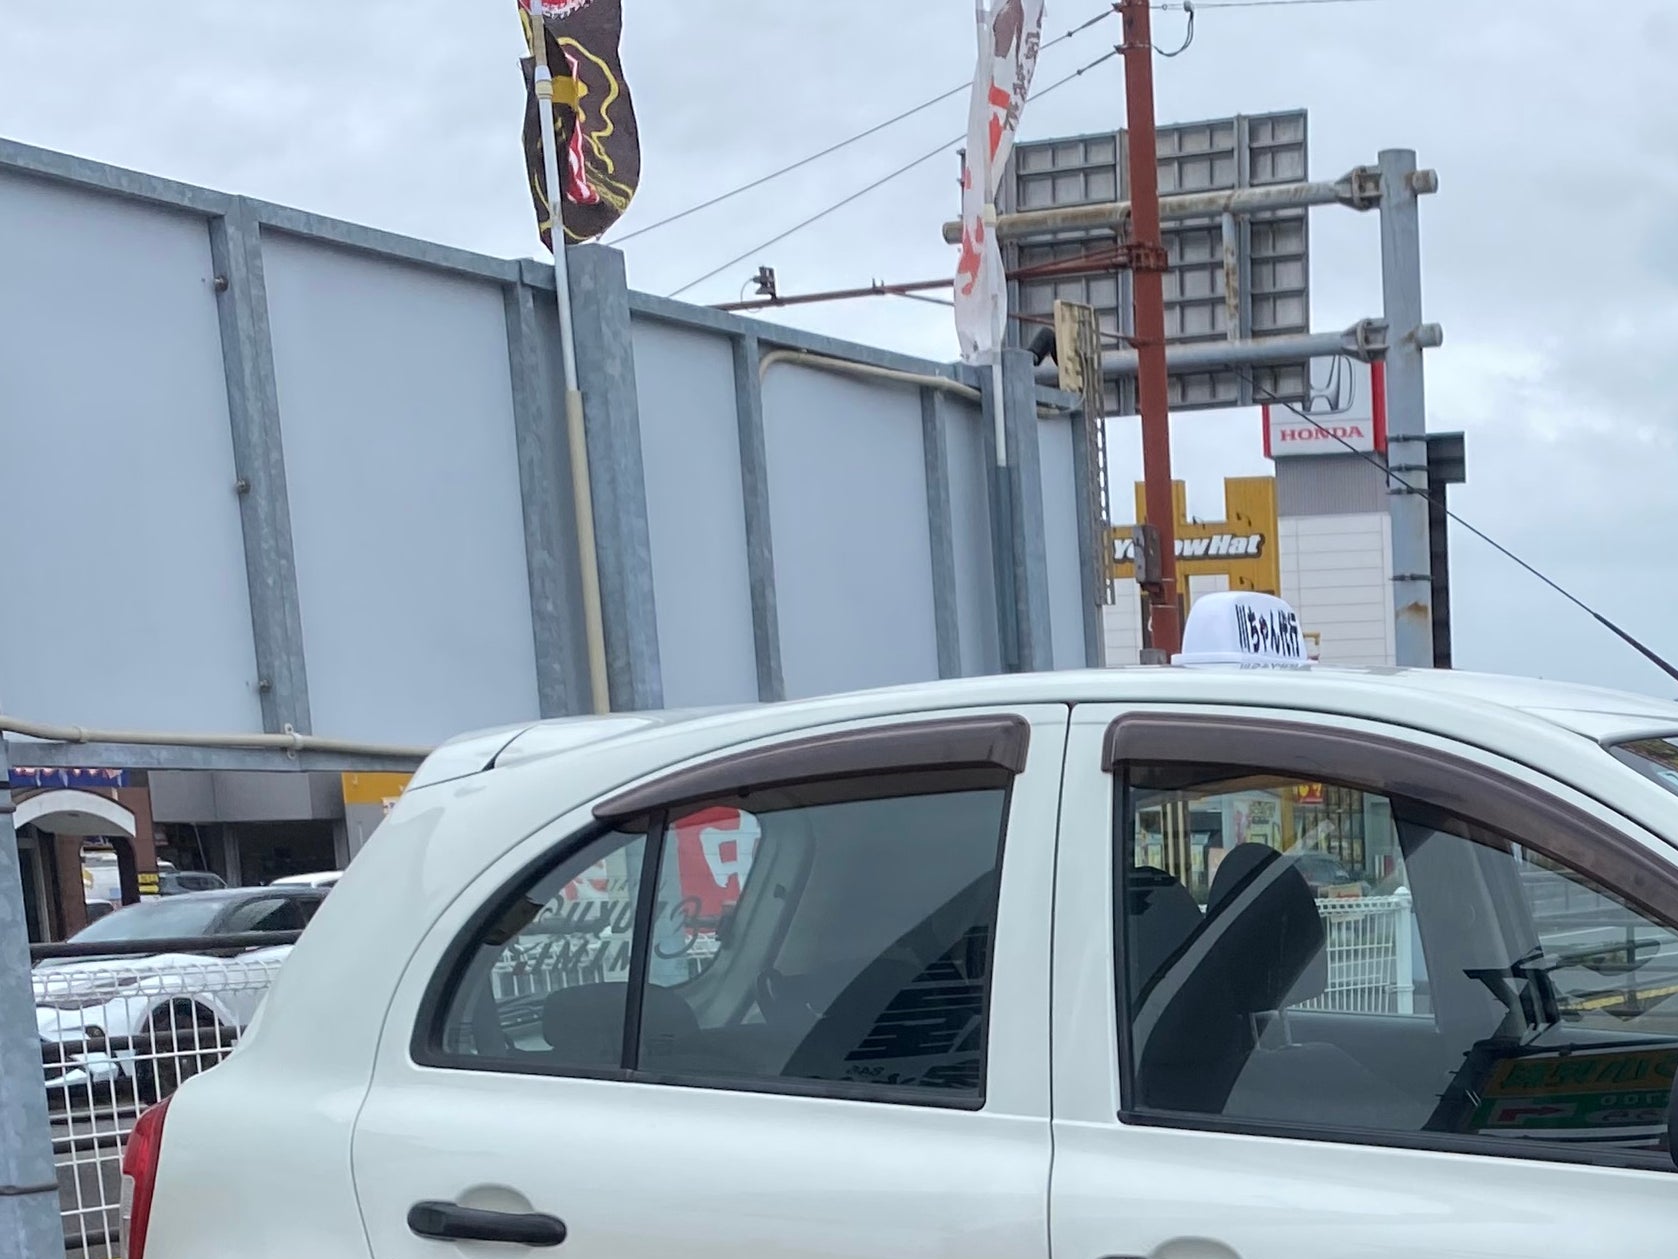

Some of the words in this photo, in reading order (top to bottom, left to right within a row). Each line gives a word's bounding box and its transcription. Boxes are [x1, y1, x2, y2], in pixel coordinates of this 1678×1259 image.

[1280, 425, 1364, 442] HONDA
[1234, 603, 1300, 658] 川ちゃん代行
